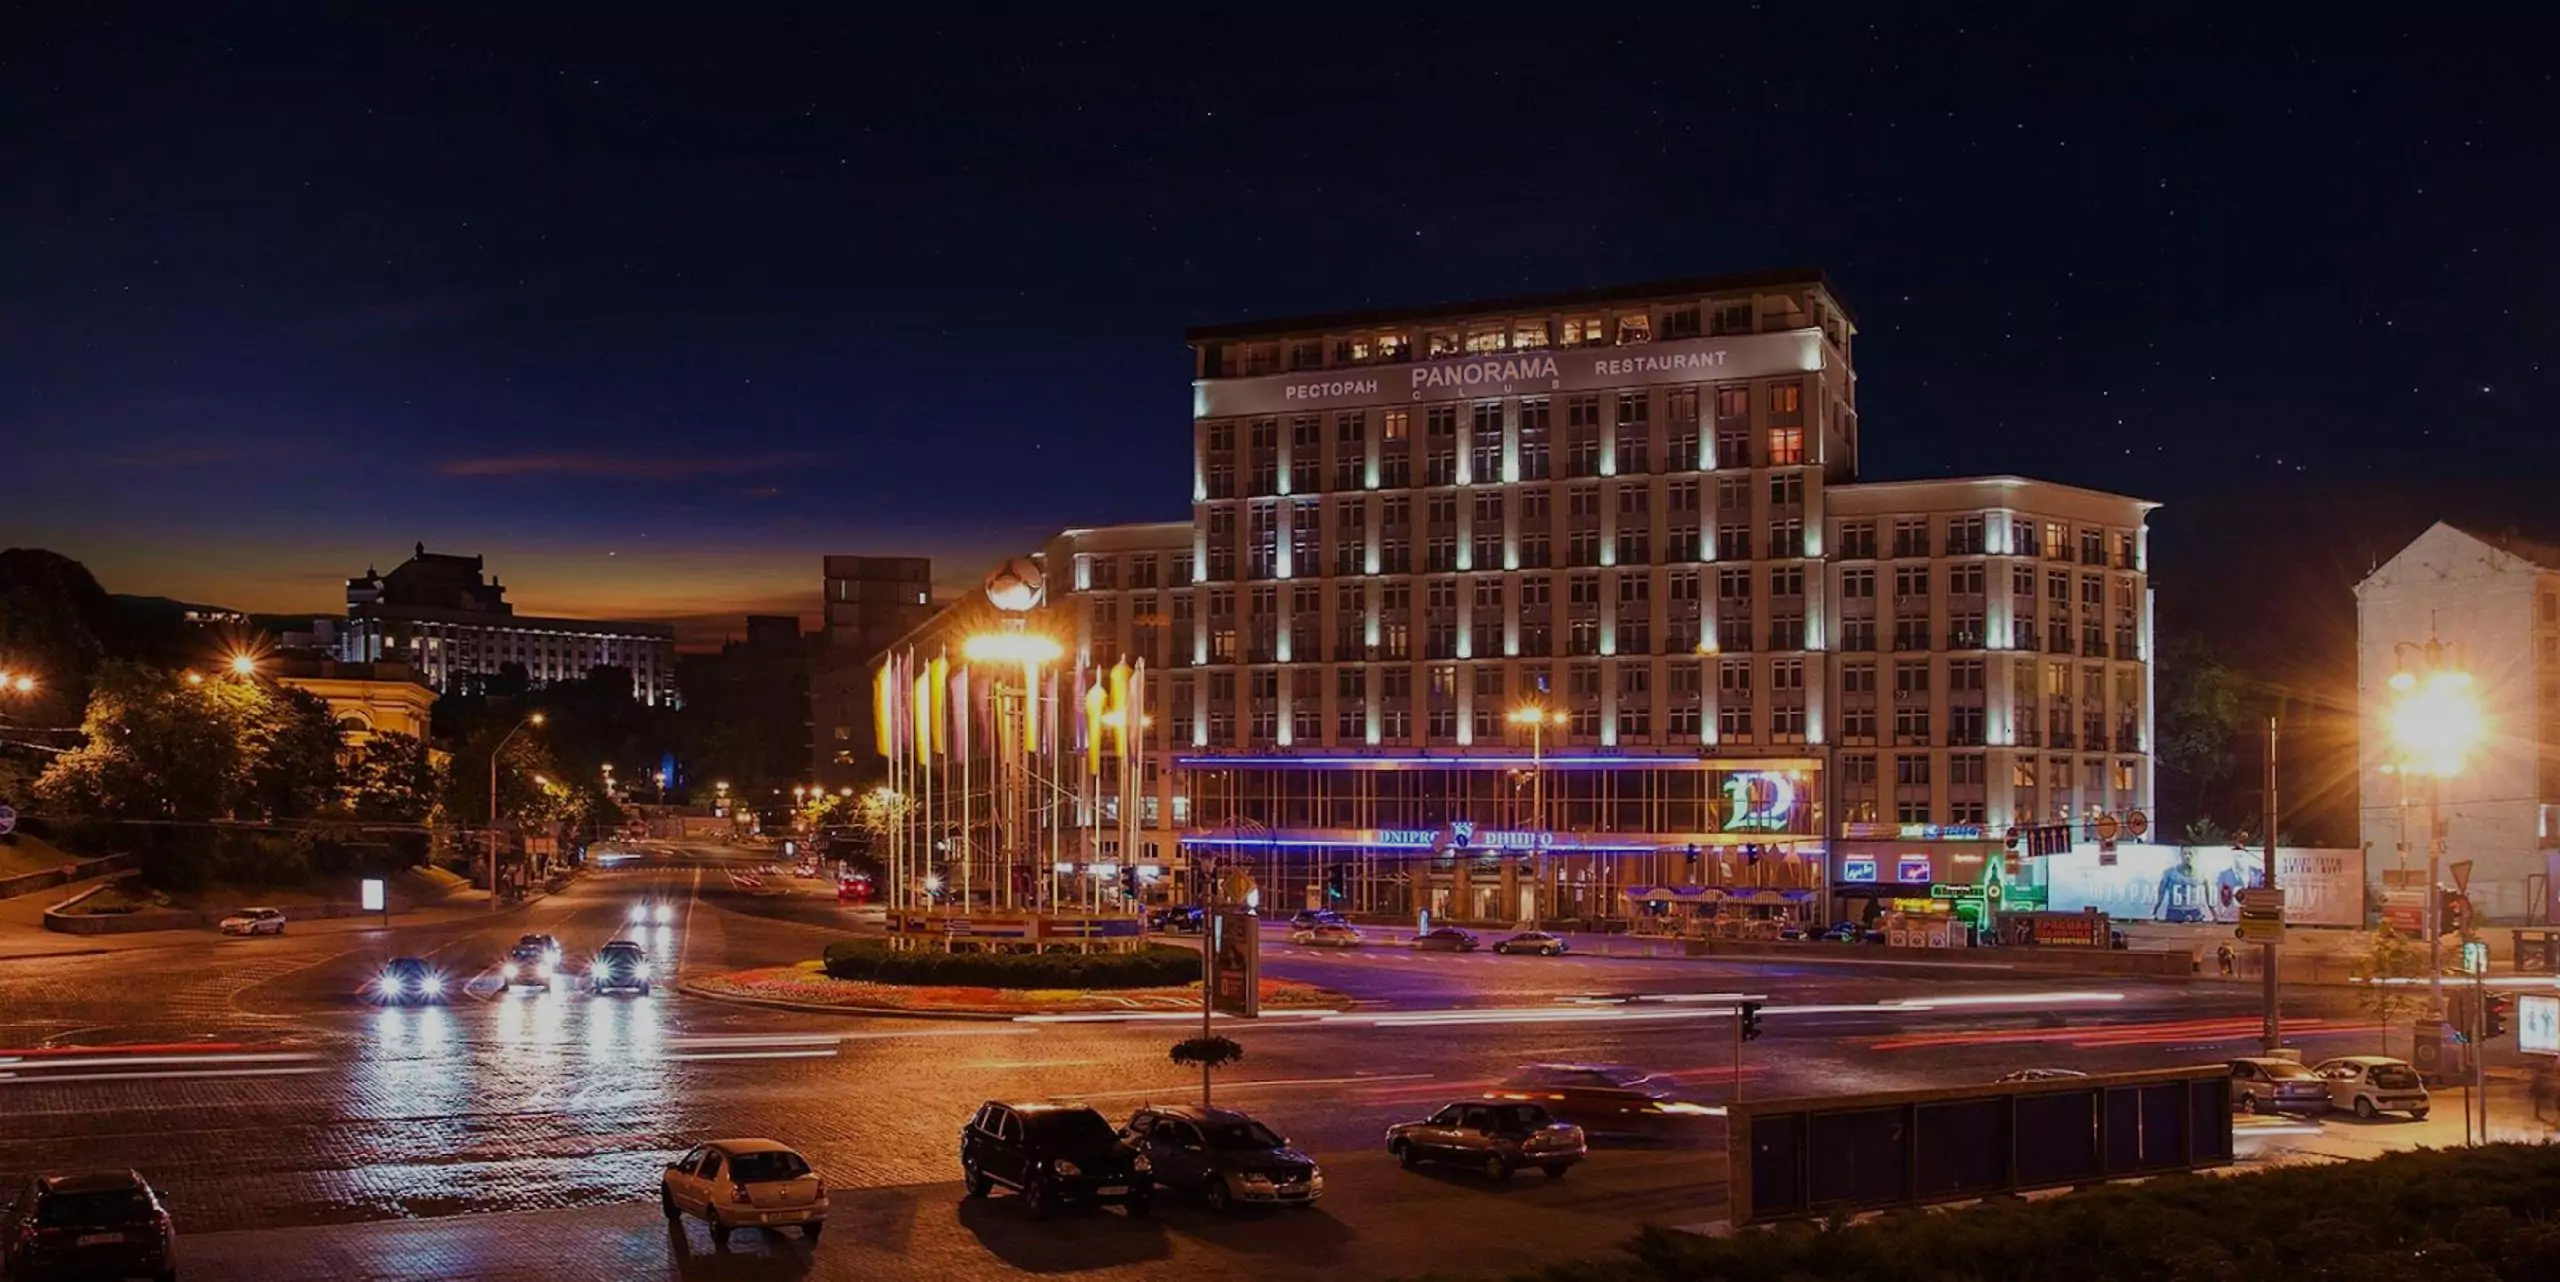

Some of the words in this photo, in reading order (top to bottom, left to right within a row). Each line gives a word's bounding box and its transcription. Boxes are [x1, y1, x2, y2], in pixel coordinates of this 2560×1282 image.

[1412, 357, 1559, 388] PANORAMA
[1594, 351, 1727, 375] RESTAURANT
[1286, 380, 1377, 400] РЕСТОРАН
